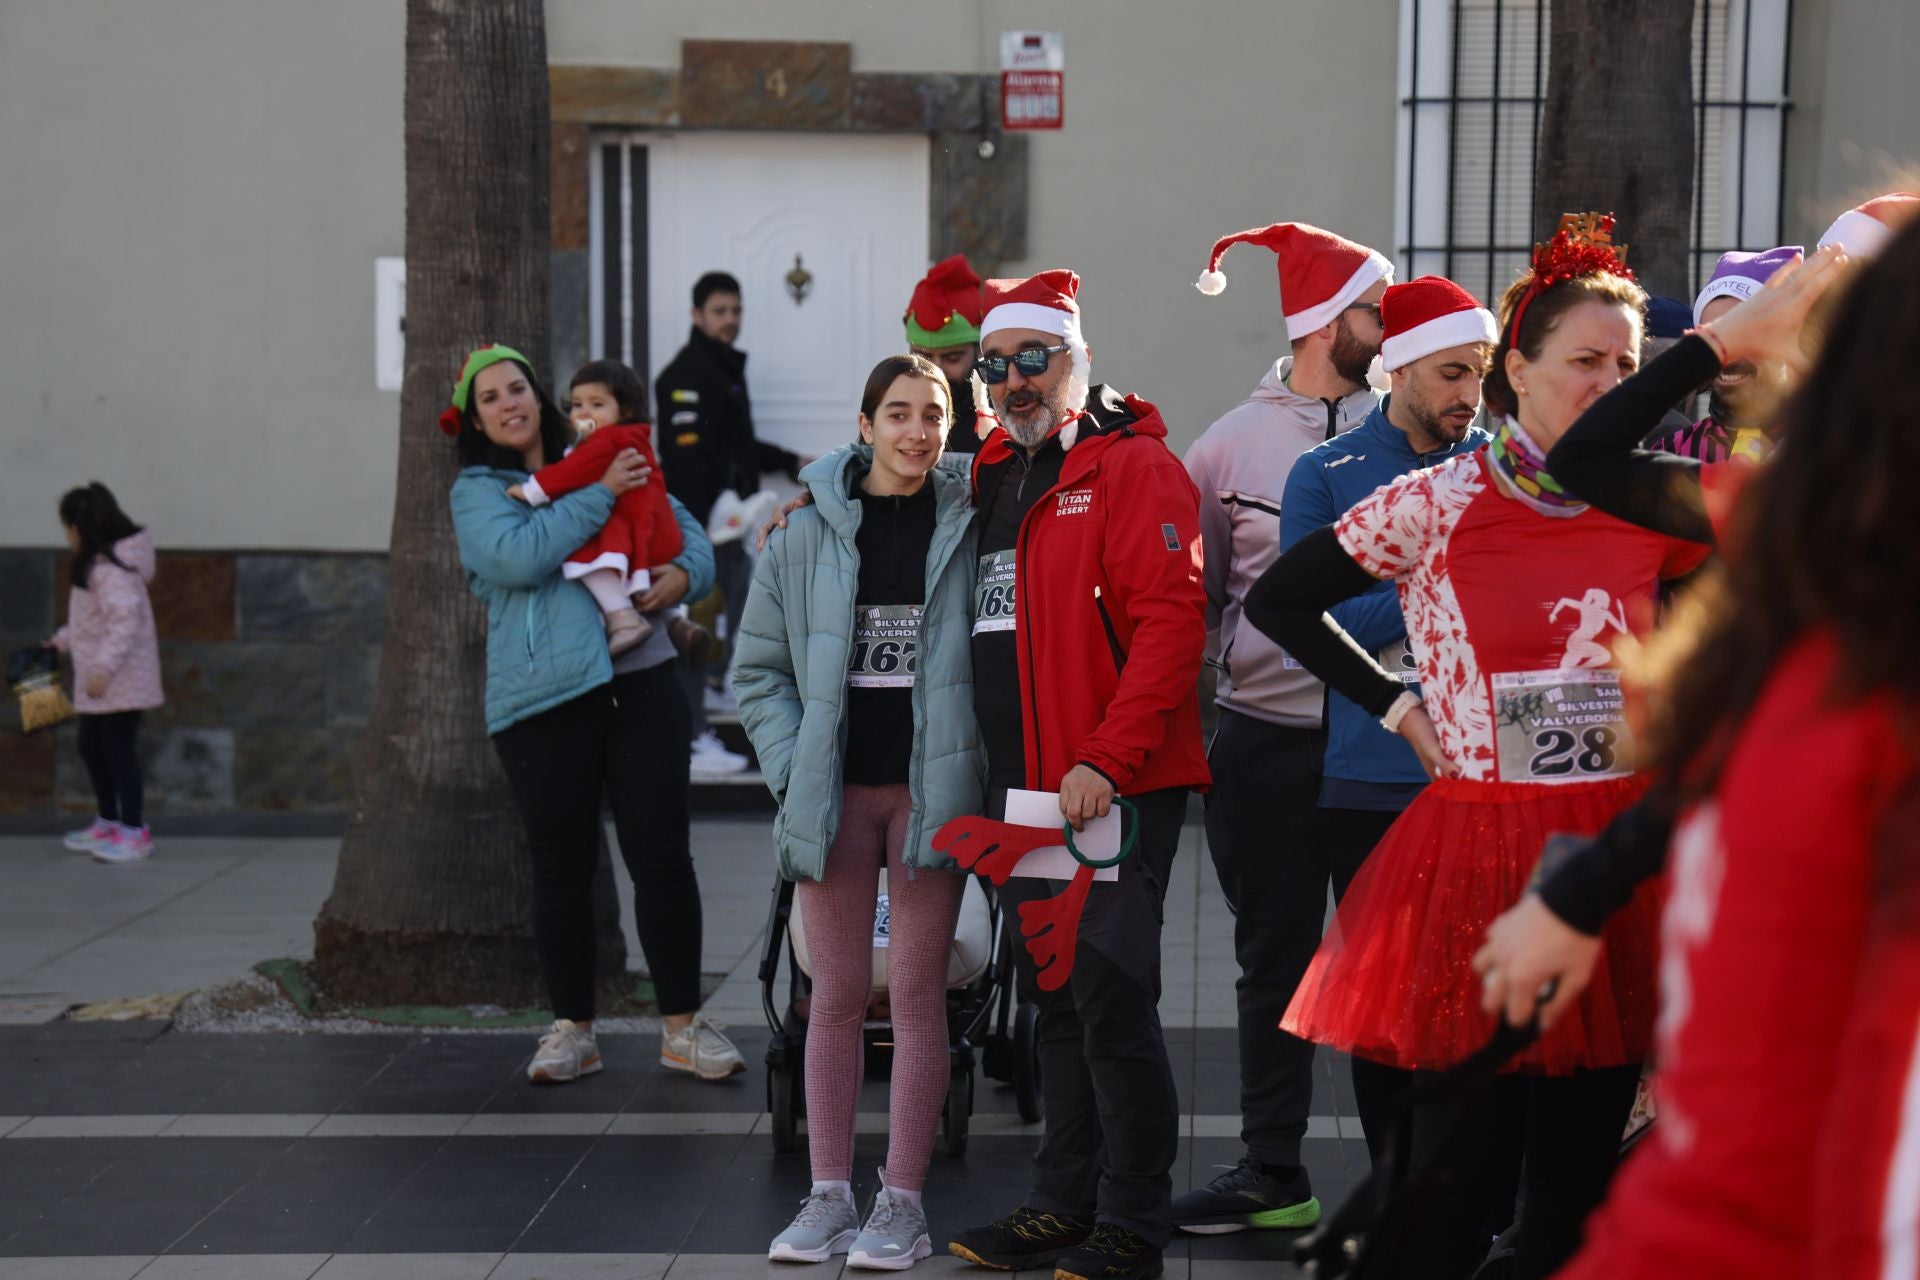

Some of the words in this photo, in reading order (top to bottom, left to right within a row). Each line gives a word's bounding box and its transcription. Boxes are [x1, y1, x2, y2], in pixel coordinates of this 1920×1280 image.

[1056, 491, 1092, 506] TITAN
[1056, 506, 1089, 516] DESERT
[976, 584, 1016, 619] 169
[1595, 688, 1622, 697] SAN
[1557, 701, 1624, 712] SILVESTRE
[1529, 725, 1617, 776] 28
